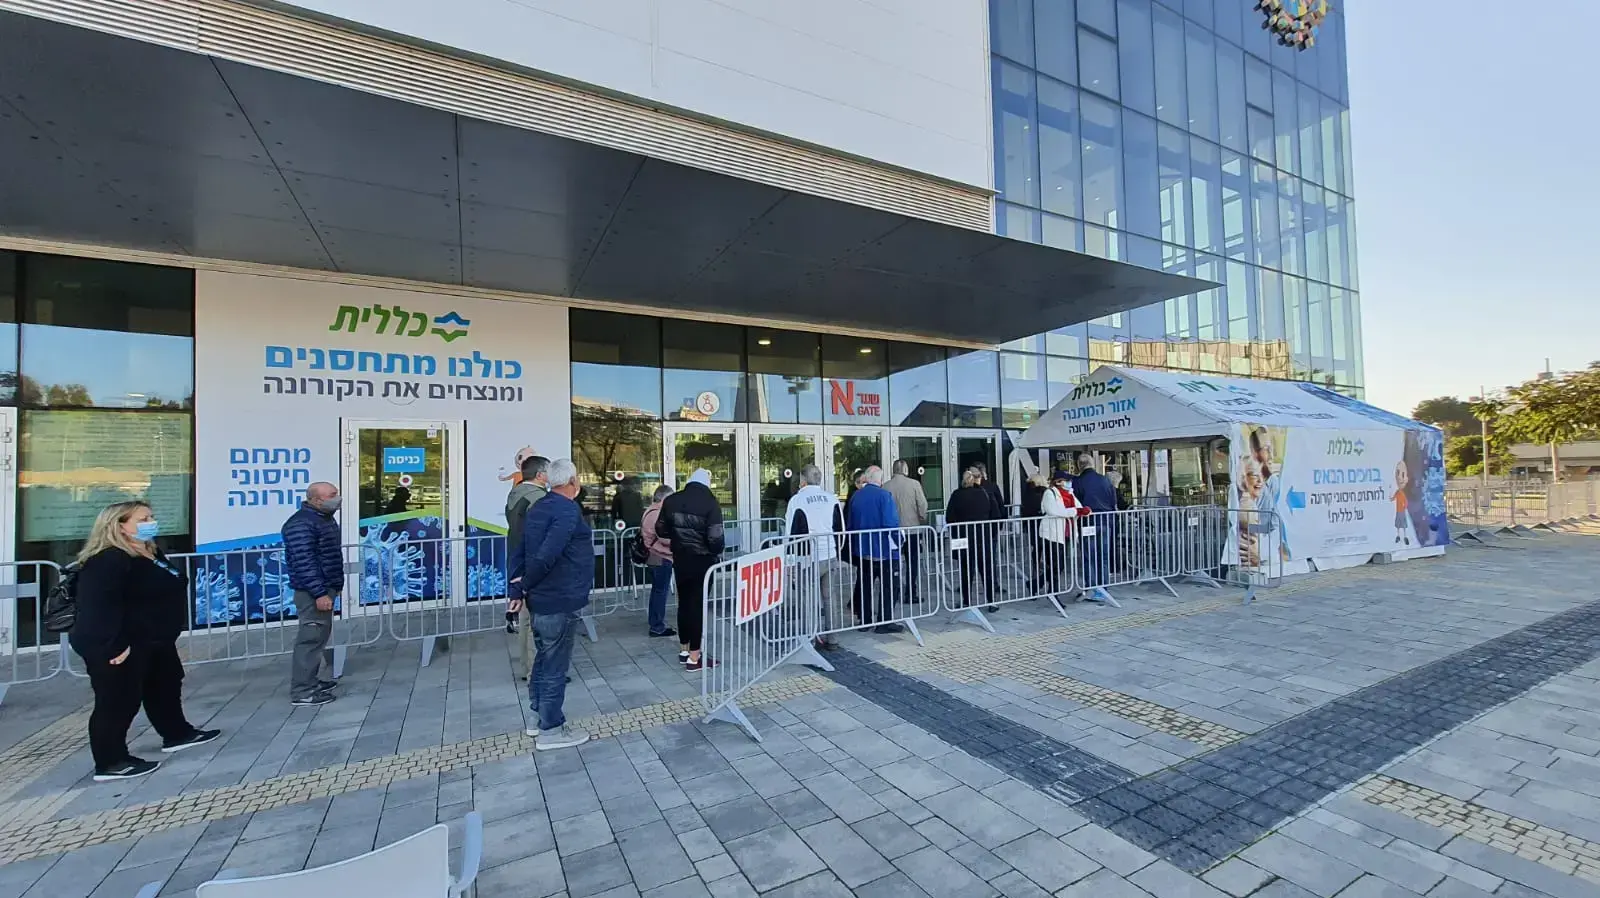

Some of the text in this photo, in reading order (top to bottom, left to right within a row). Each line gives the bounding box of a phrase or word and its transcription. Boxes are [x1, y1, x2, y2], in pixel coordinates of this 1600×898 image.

[329, 304, 428, 337] כללית
[265, 345, 522, 379] כולנו מתחסנים
[263, 376, 523, 402] ומנצחים את הקורונה
[856, 392, 880, 405] שער
[1072, 382, 1106, 401] כללית
[857, 406, 881, 416] GATE
[1062, 398, 1137, 421] אזור המתנה
[1069, 415, 1131, 434] לחיסוני קורונה
[230, 448, 311, 464] מתחם
[1327, 438, 1353, 455] כללית
[388, 455, 420, 465] כניסה
[231, 468, 310, 485] חיסוני
[740, 556, 782, 618] כניסה
